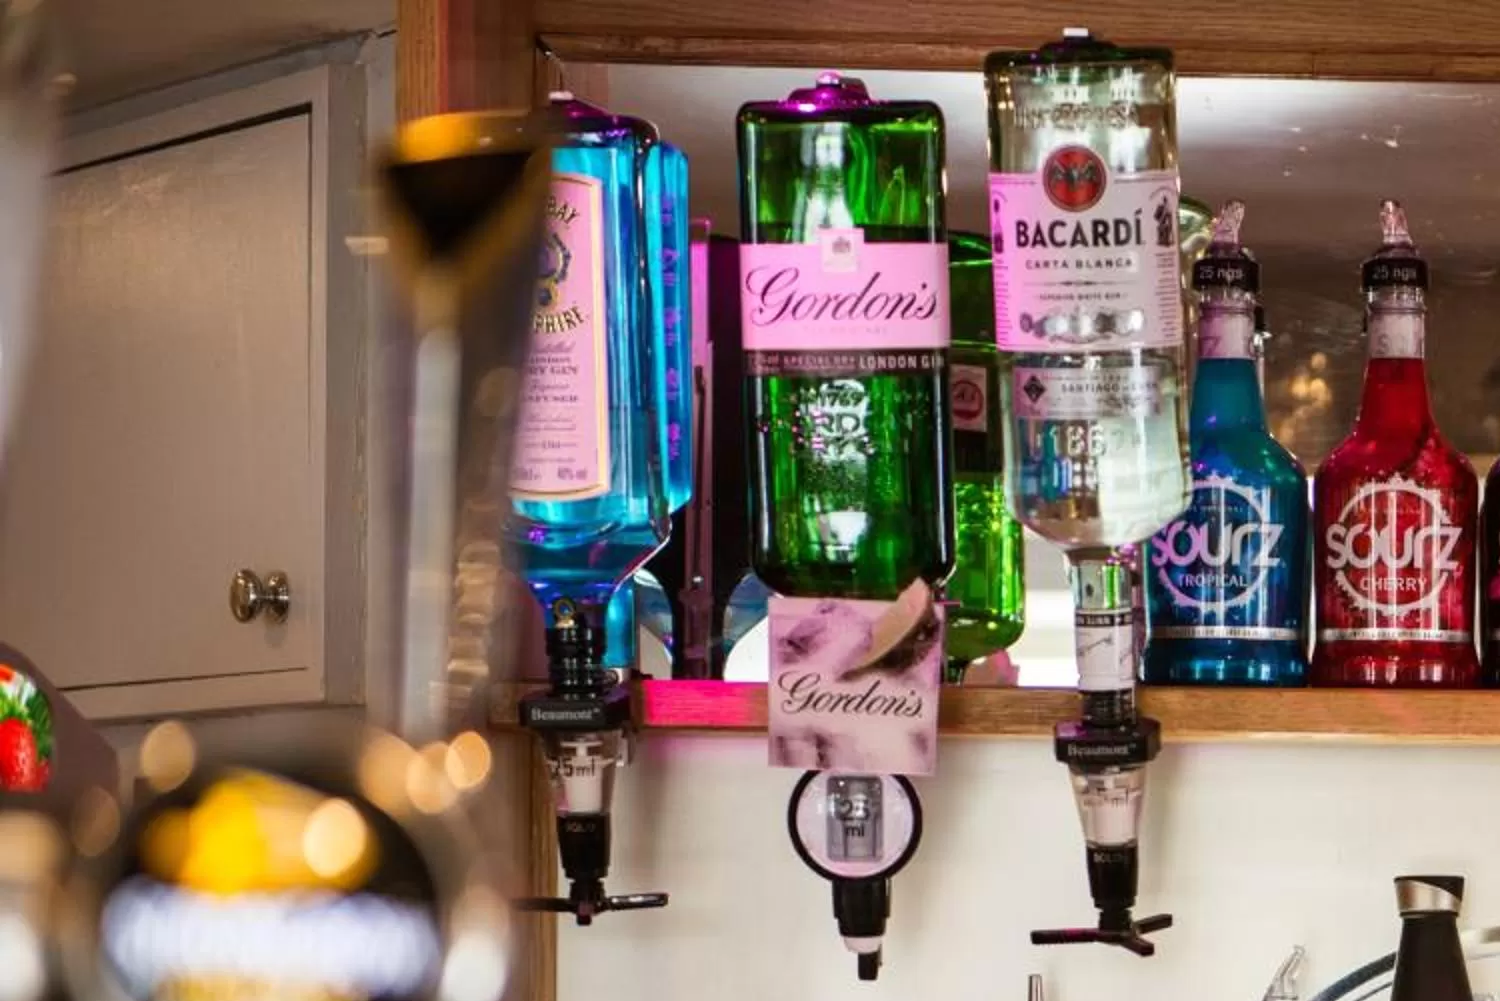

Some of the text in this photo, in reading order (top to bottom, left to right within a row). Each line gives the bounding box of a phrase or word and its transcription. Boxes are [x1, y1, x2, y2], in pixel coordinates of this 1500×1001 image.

[1015, 207, 1143, 249] BACARDÍ
[1025, 258, 1133, 271] CARTA BLANCA
[745, 266, 938, 328] Gordon's
[859, 354, 945, 369] LONDON GIN
[1178, 573, 1247, 588] TROPICAL
[1359, 576, 1428, 593] CHERRY
[777, 669, 923, 719] Gordon's
